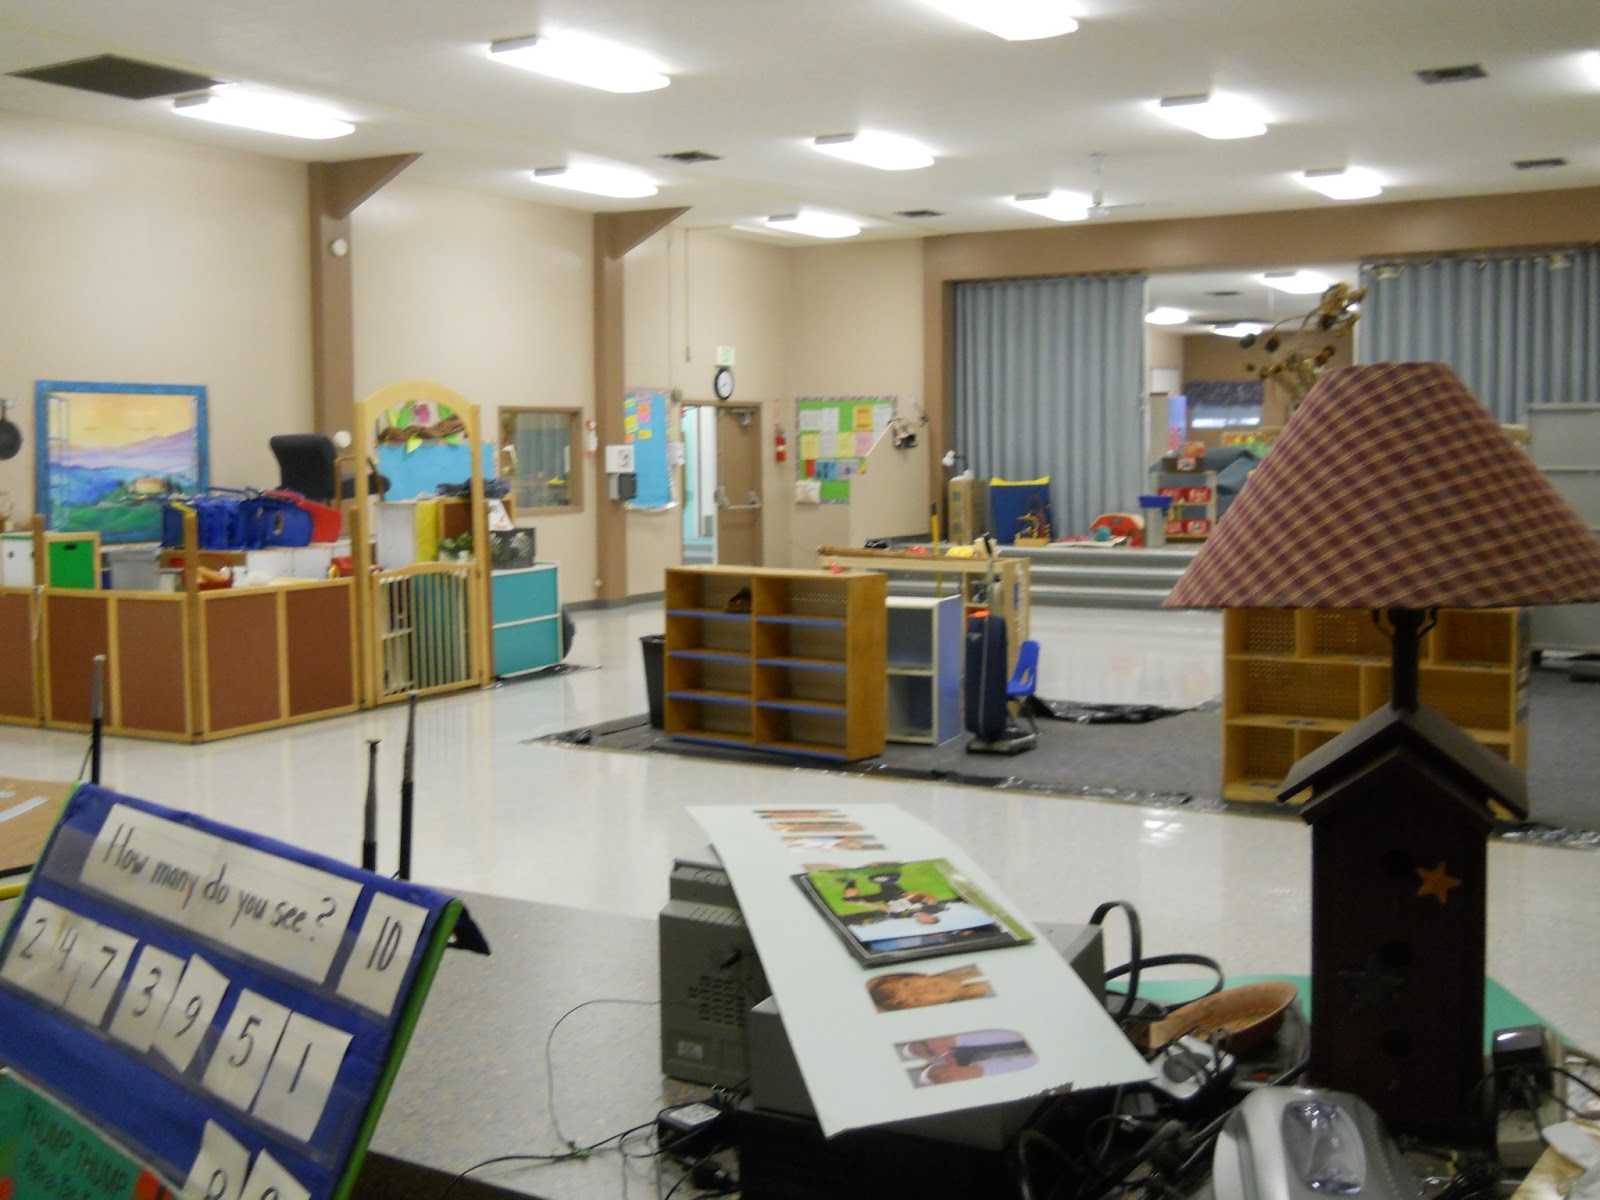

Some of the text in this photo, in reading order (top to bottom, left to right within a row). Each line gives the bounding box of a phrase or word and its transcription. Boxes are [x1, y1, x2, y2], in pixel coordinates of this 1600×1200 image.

[103, 823, 336, 942] How many do you see?
[366, 914, 403, 972] 10
[19, 917, 313, 1094] 2 4 7 3 9 5 1
